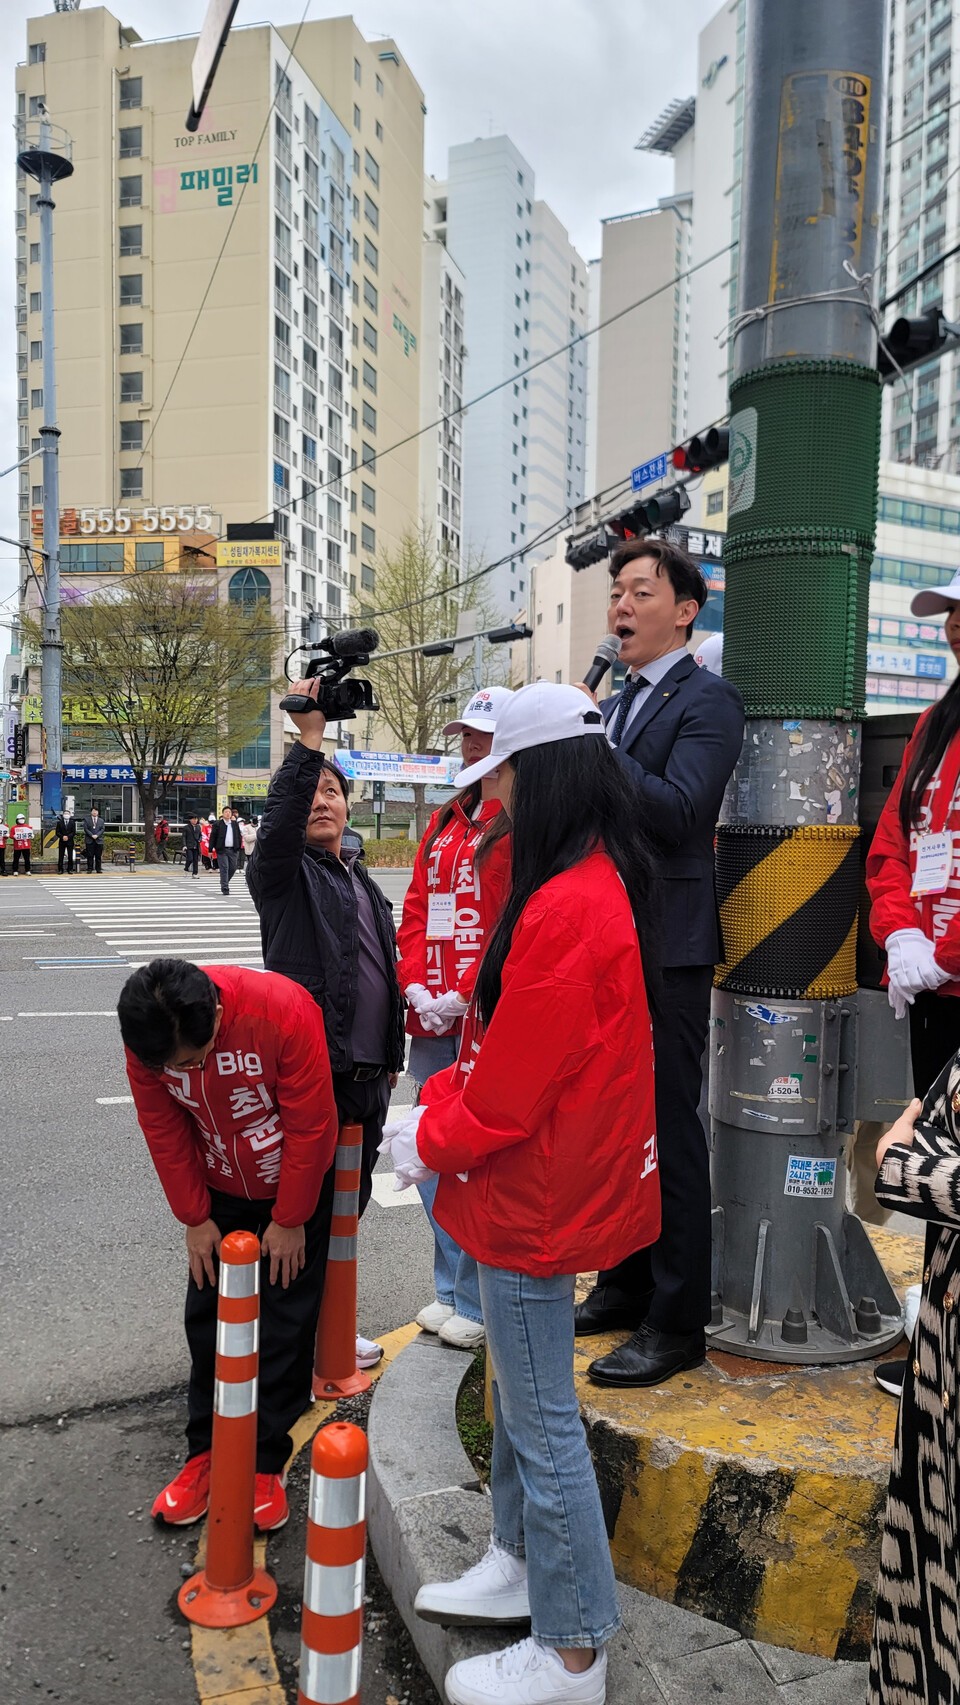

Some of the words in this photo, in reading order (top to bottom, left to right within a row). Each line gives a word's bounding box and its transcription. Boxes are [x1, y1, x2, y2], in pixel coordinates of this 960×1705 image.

[174, 136, 195, 148] TOP
[197, 130, 238, 145] FAMILY
[216, 1050, 263, 1076] Big
